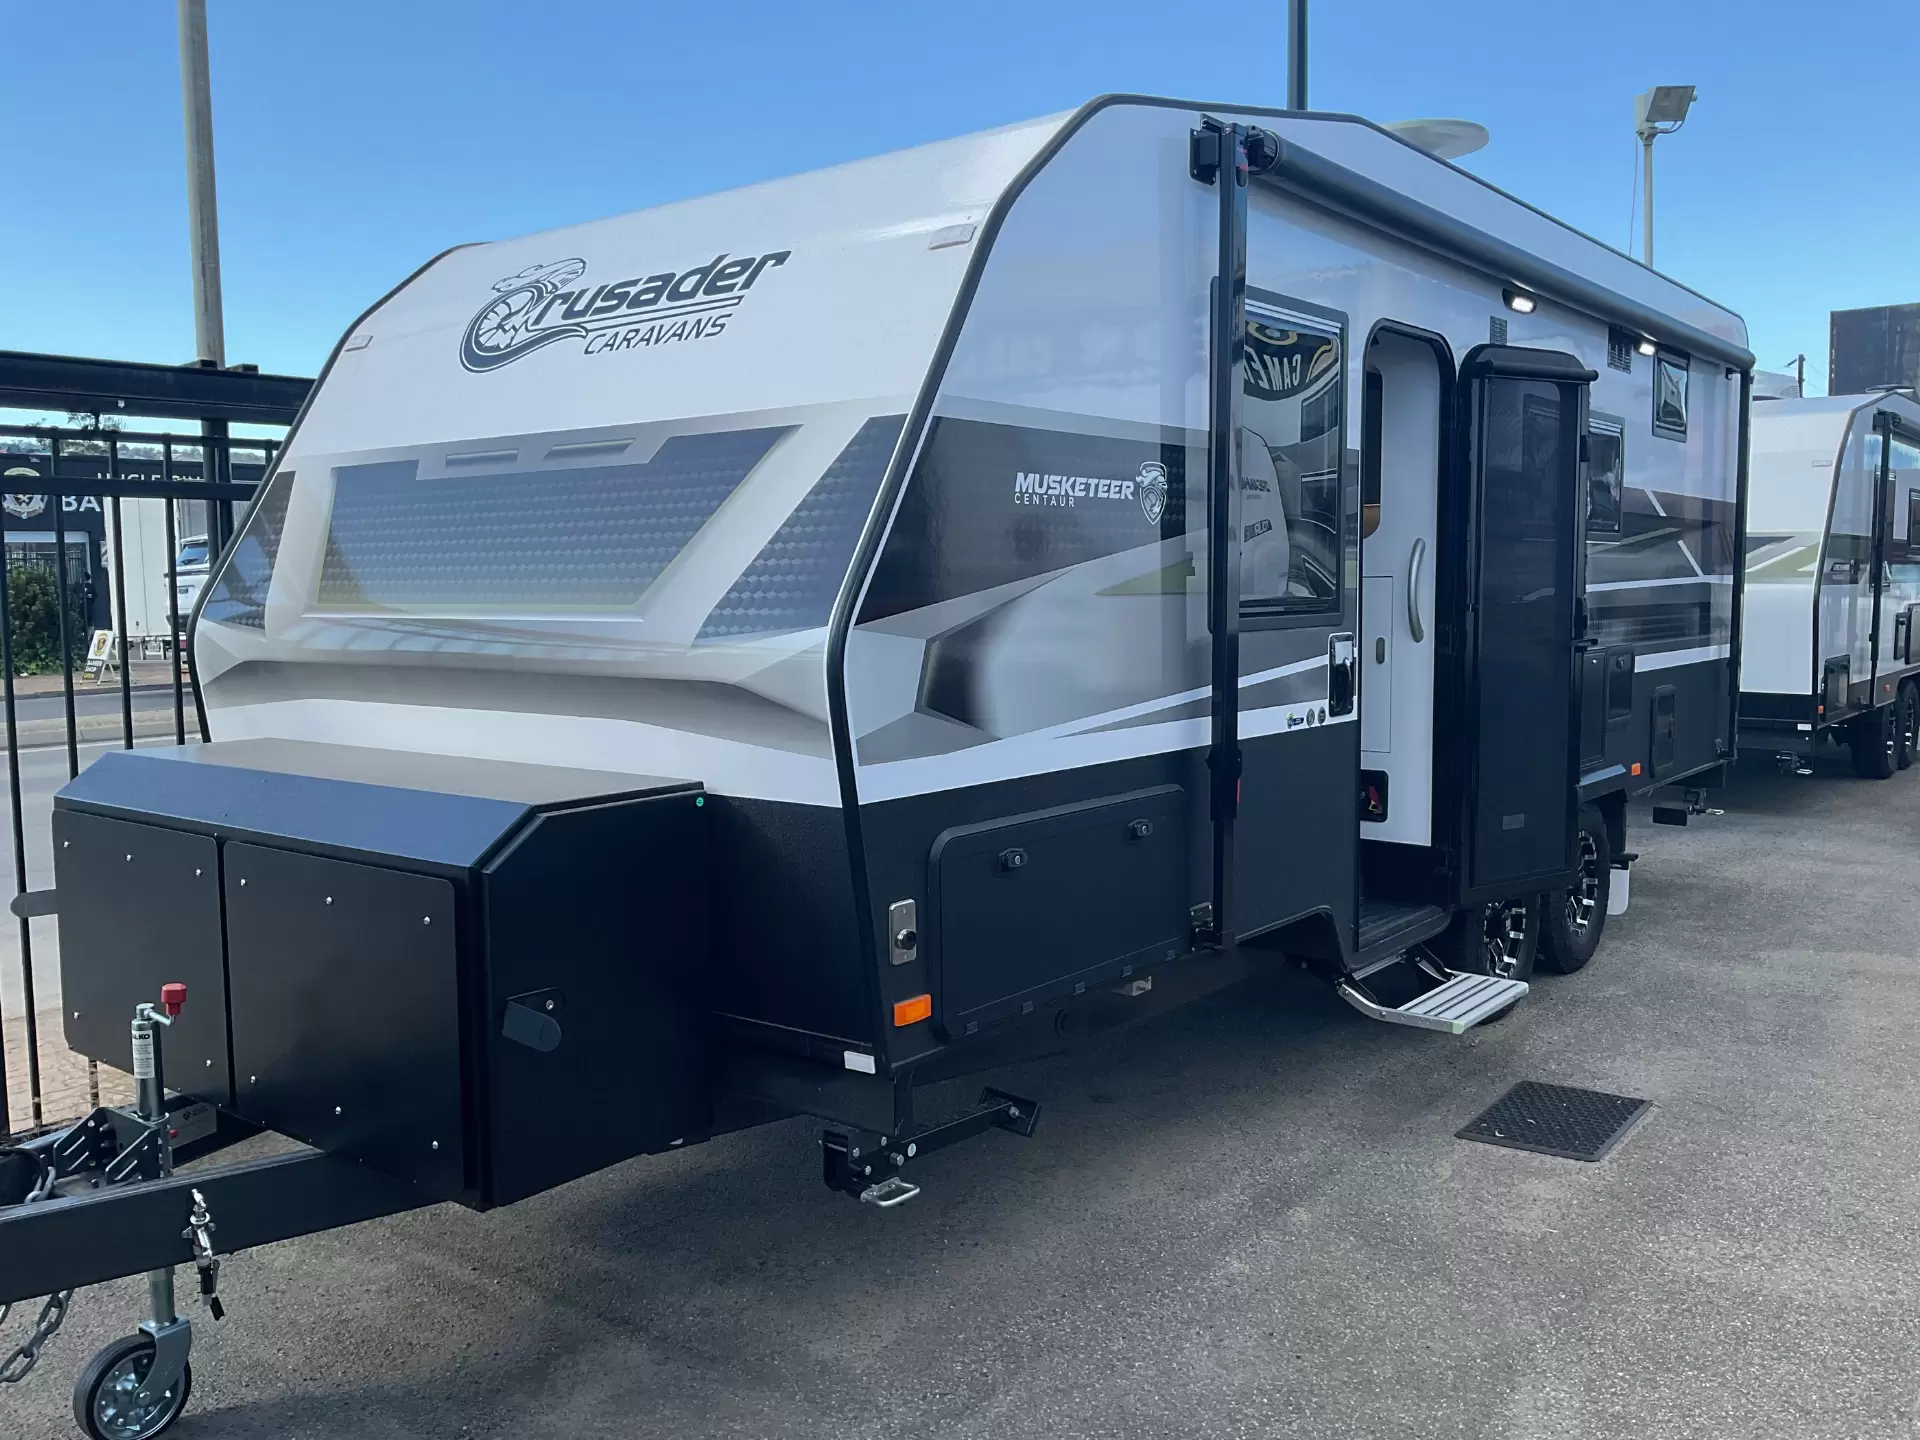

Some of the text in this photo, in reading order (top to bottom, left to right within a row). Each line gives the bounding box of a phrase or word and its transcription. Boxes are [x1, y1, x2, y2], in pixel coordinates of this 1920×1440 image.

[583, 313, 733, 356] CARAVANS
[1014, 471, 1135, 500] MUSKETEER
[1014, 492, 1075, 508] CENTAUR
